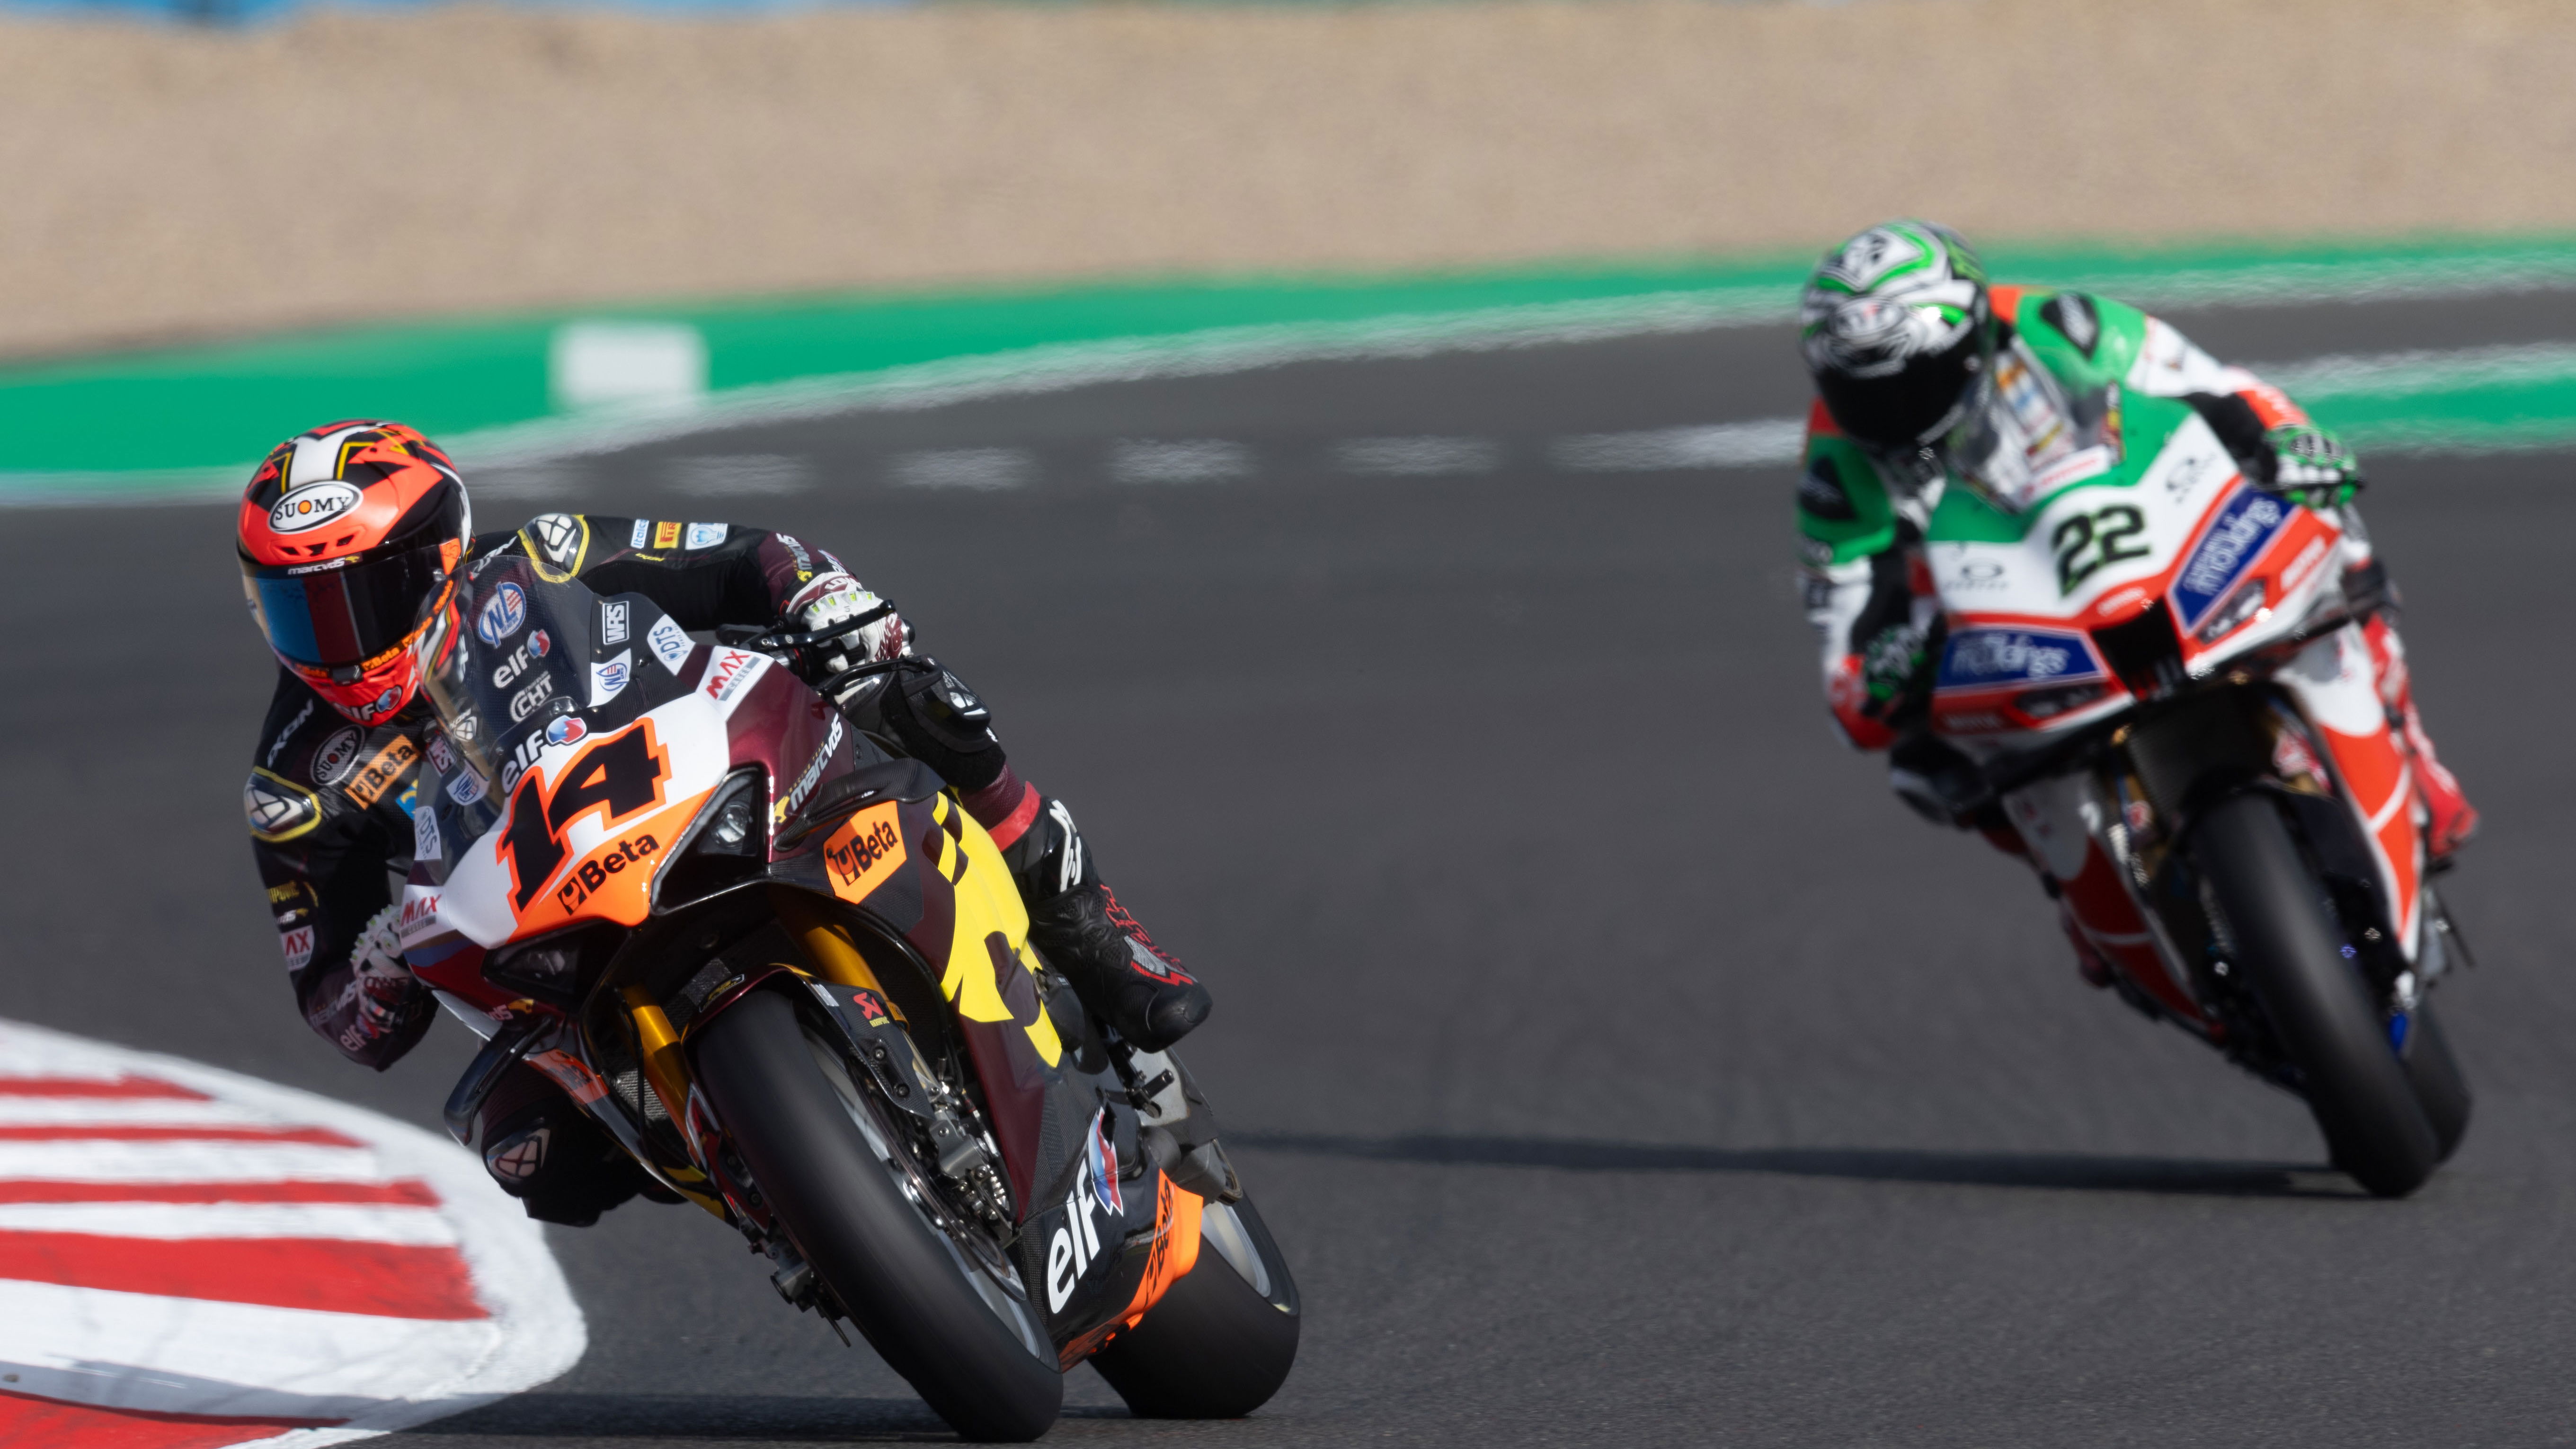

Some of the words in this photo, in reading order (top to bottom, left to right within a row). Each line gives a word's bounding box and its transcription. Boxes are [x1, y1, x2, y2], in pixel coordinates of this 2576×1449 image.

[275, 496, 350, 521] SUOMY
[2052, 503, 2151, 597] 22
[606, 605, 625, 643] WRS
[653, 626, 681, 654] DTS
[493, 644, 529, 689] elf
[706, 650, 751, 699] MAX
[513, 673, 552, 718] CHT
[315, 731, 357, 780] SUOMY
[369, 743, 415, 792] Beta
[501, 733, 543, 795] elf
[420, 819, 437, 854] DTS
[499, 721, 665, 916] 14
[577, 833, 659, 894] Beta
[852, 820, 897, 870] Beta
[286, 930, 311, 956] AX
[1048, 1157, 1101, 1314] elf
